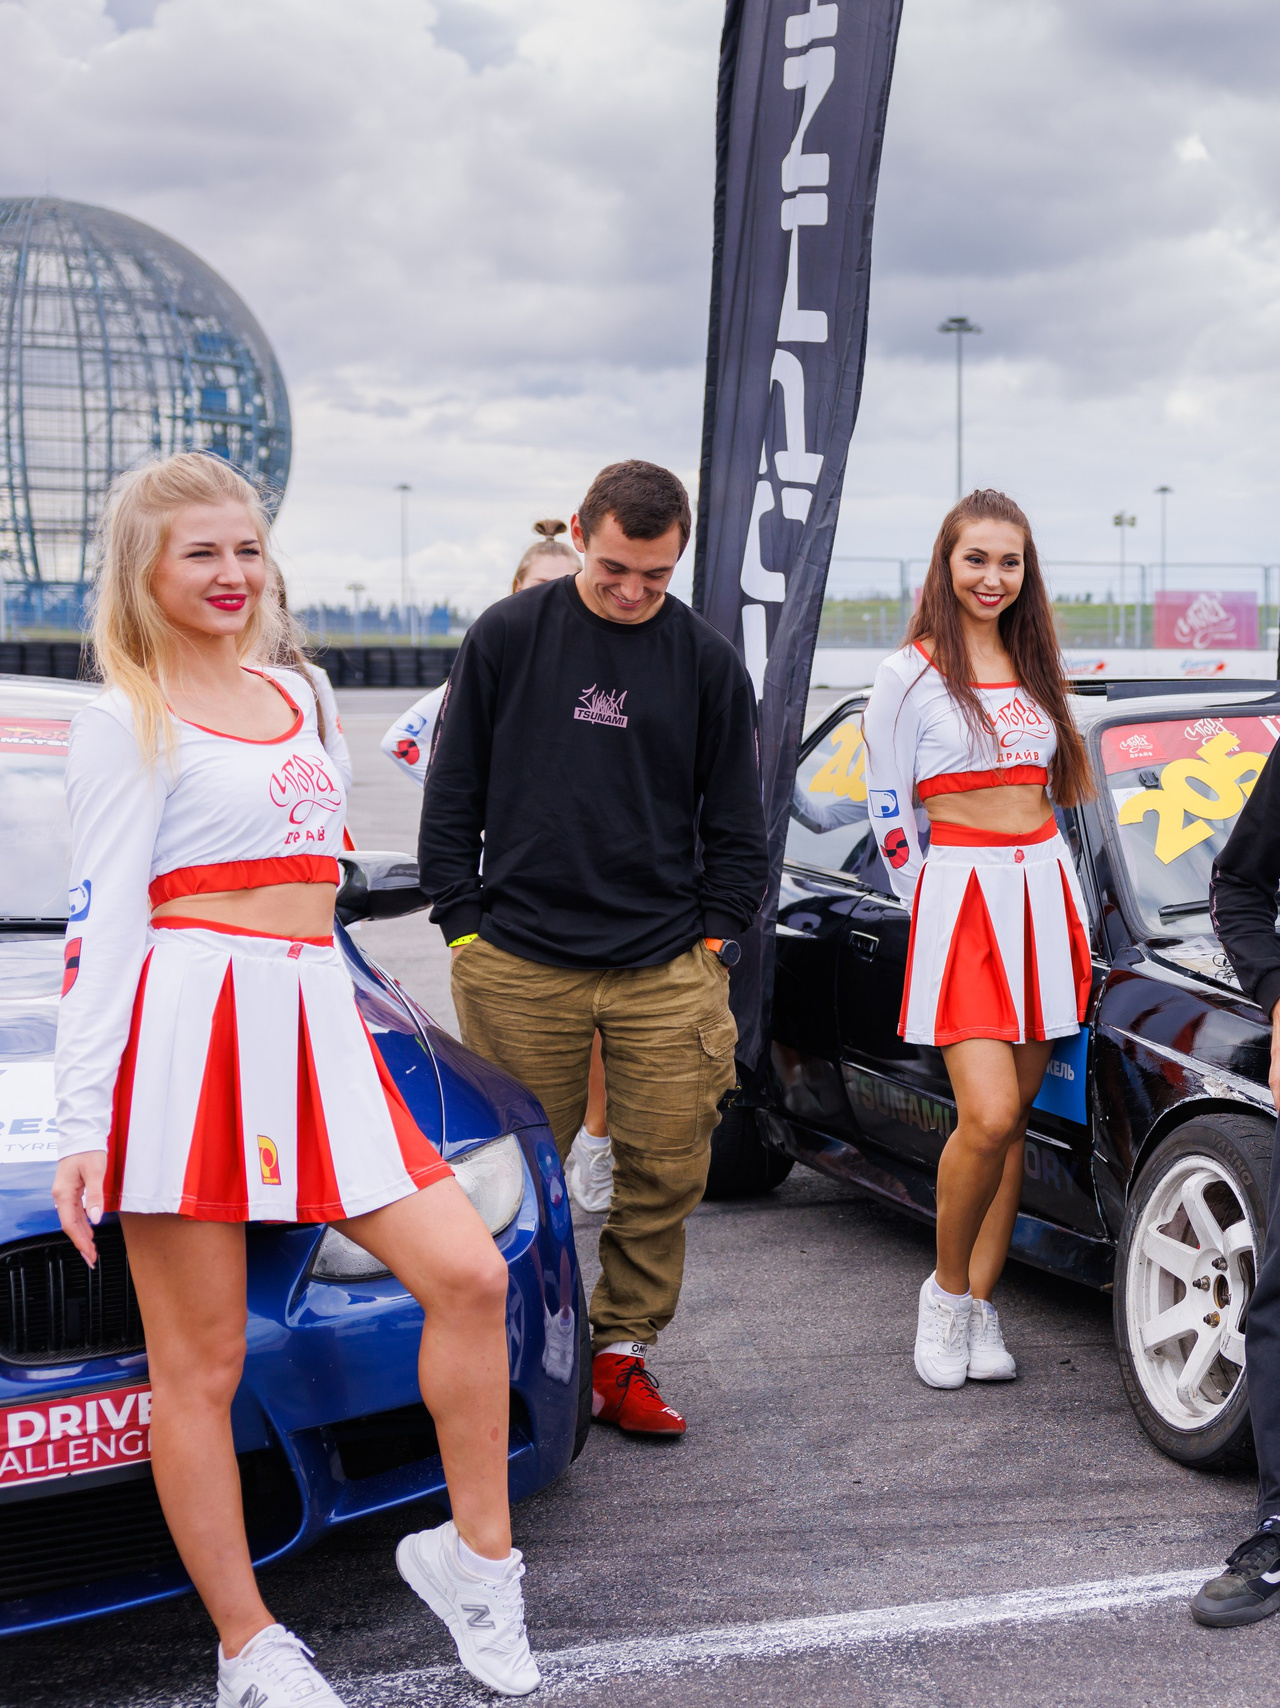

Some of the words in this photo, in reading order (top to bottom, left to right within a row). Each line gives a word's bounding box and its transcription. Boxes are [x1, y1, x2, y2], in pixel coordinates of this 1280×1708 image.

[577, 709, 625, 726] TSUNAMI
[807, 722, 868, 802] 20
[996, 749, 1040, 763] ДРАЙВ
[1118, 731, 1268, 866] 205
[1046, 1059, 1075, 1081] КЕЛЬ
[846, 1072, 951, 1140] TSUNAMI
[1024, 1141, 1080, 1196] ORY
[7, 1391, 152, 1448] DRIVE
[0, 1430, 152, 1477] ALLENG
